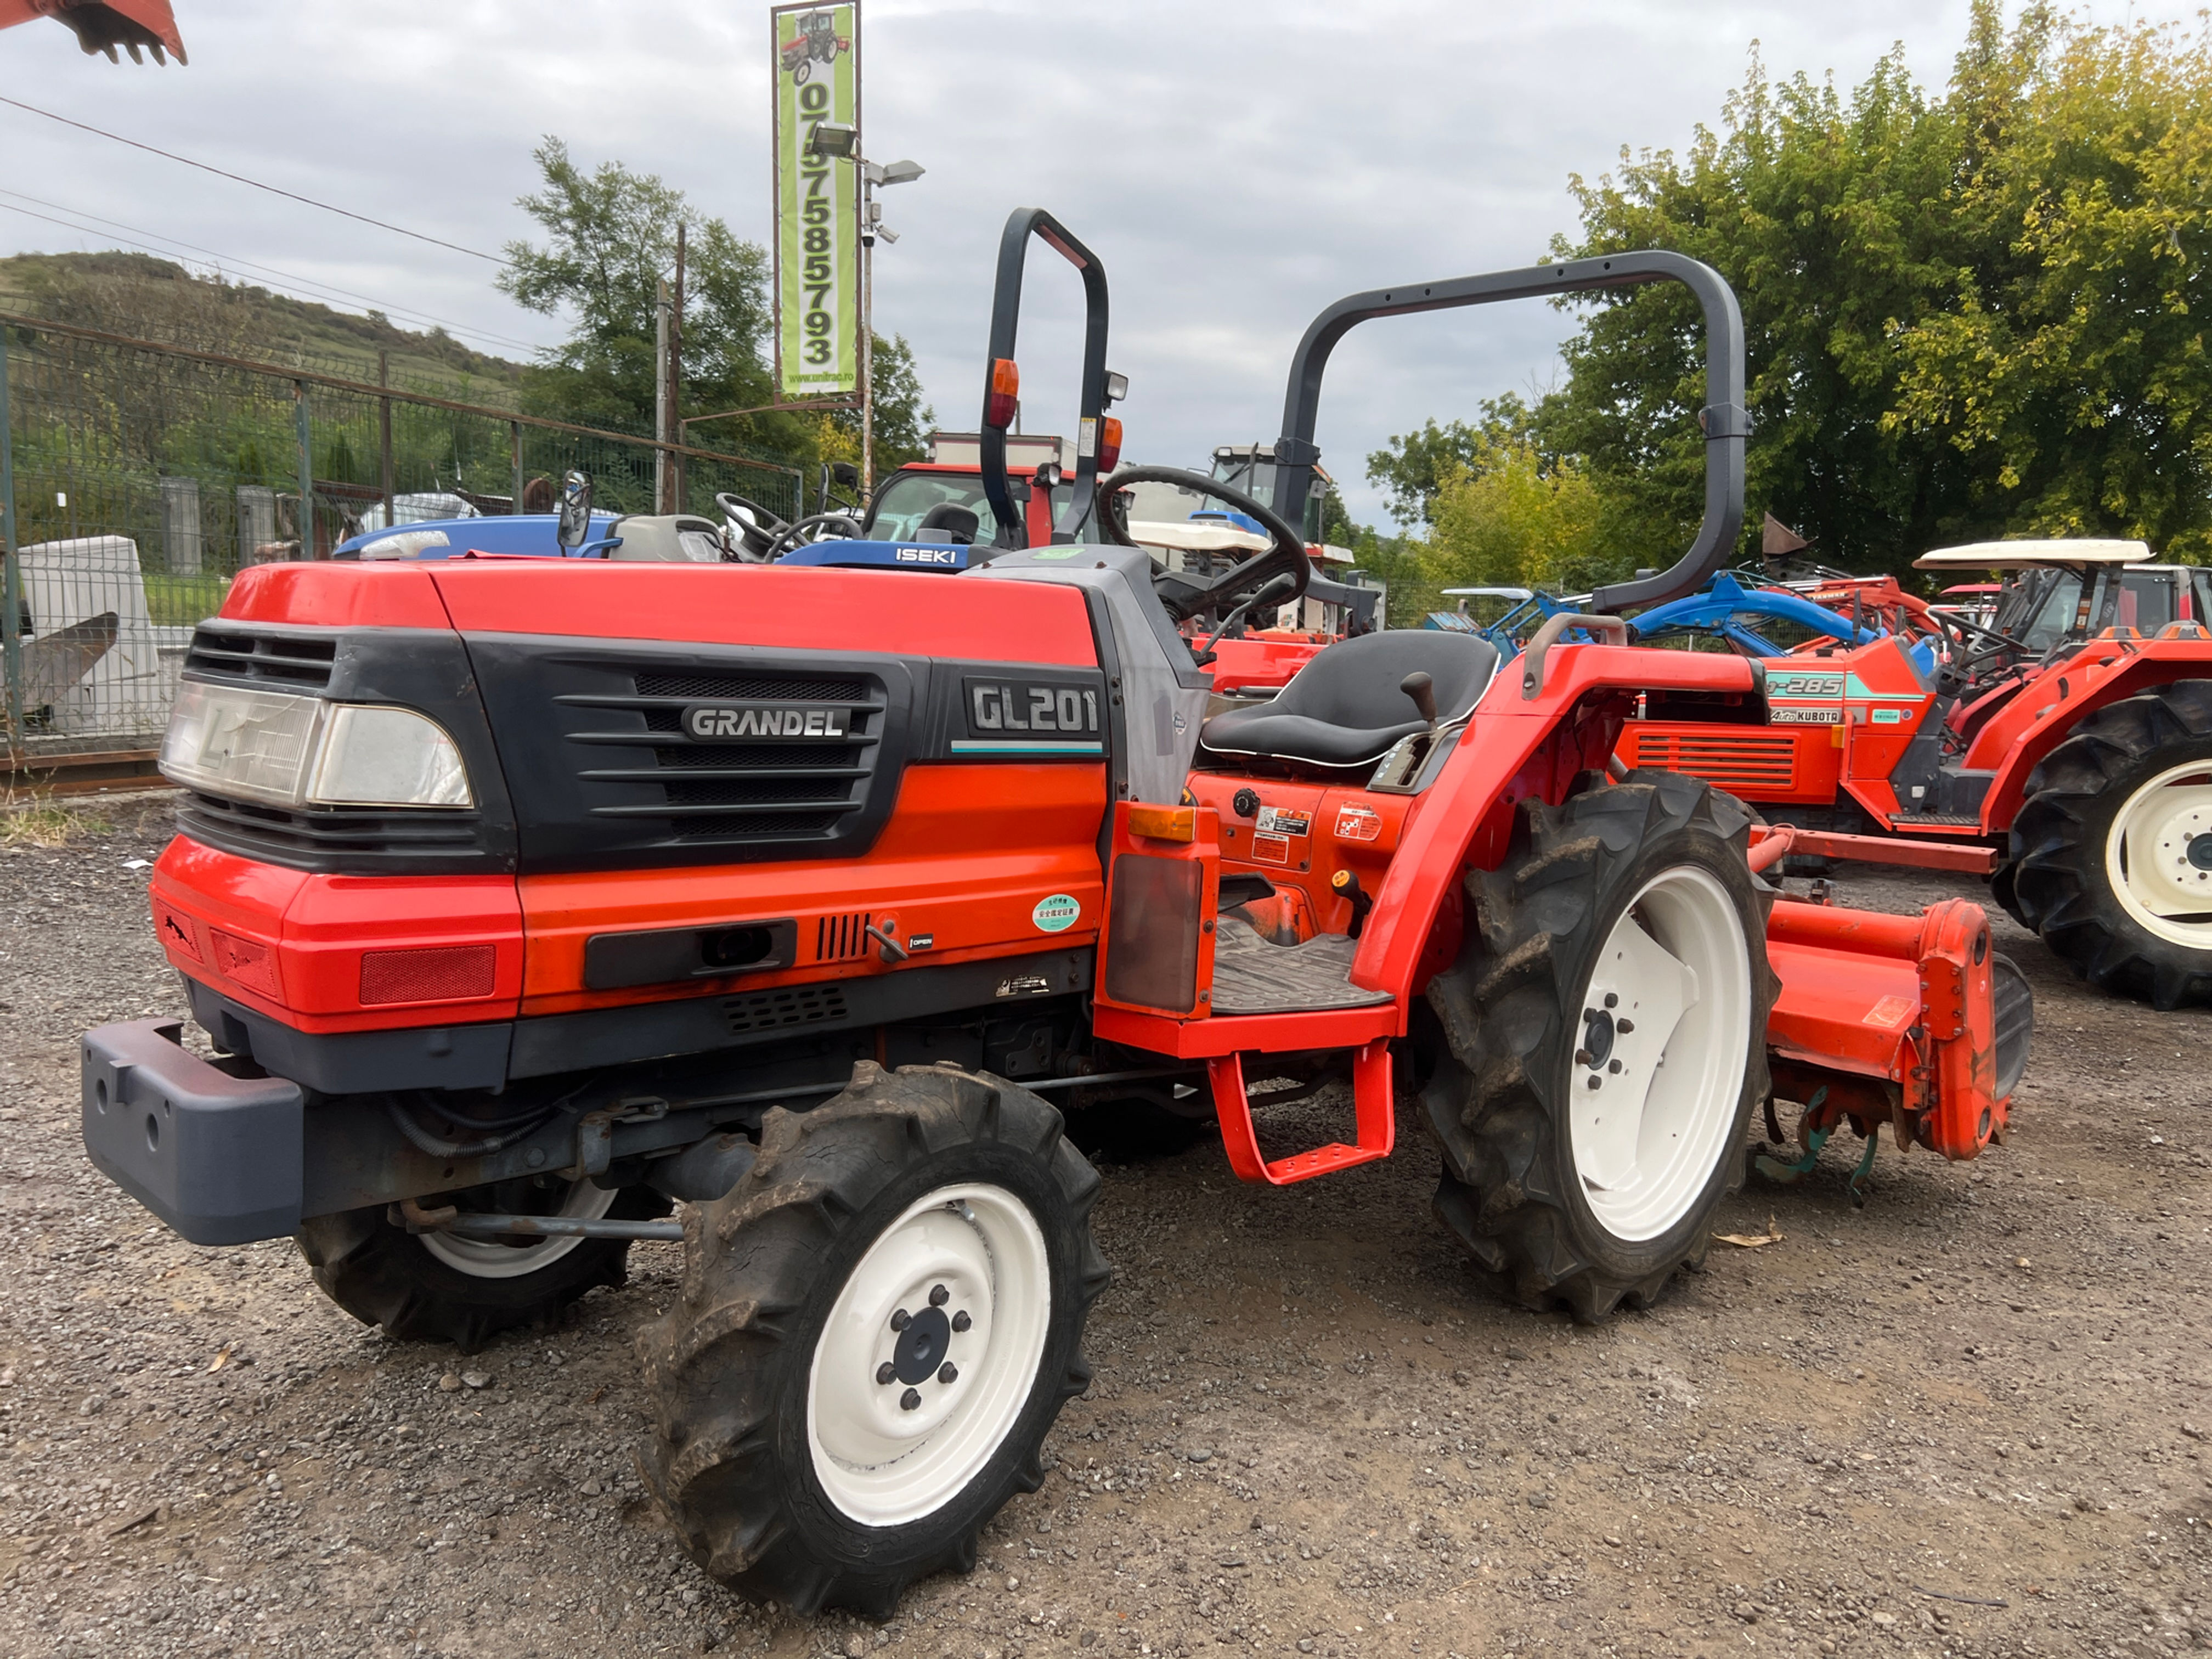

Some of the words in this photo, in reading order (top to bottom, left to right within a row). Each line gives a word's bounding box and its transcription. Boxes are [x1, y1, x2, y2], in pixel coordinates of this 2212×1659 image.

[788, 372, 854, 383] www.unitrac.ro
[896, 548, 956, 564] ISEKI
[973, 686, 1098, 731] GL201
[692, 709, 843, 736] GRANDEL
[1797, 712, 1838, 722] KUBOTA
